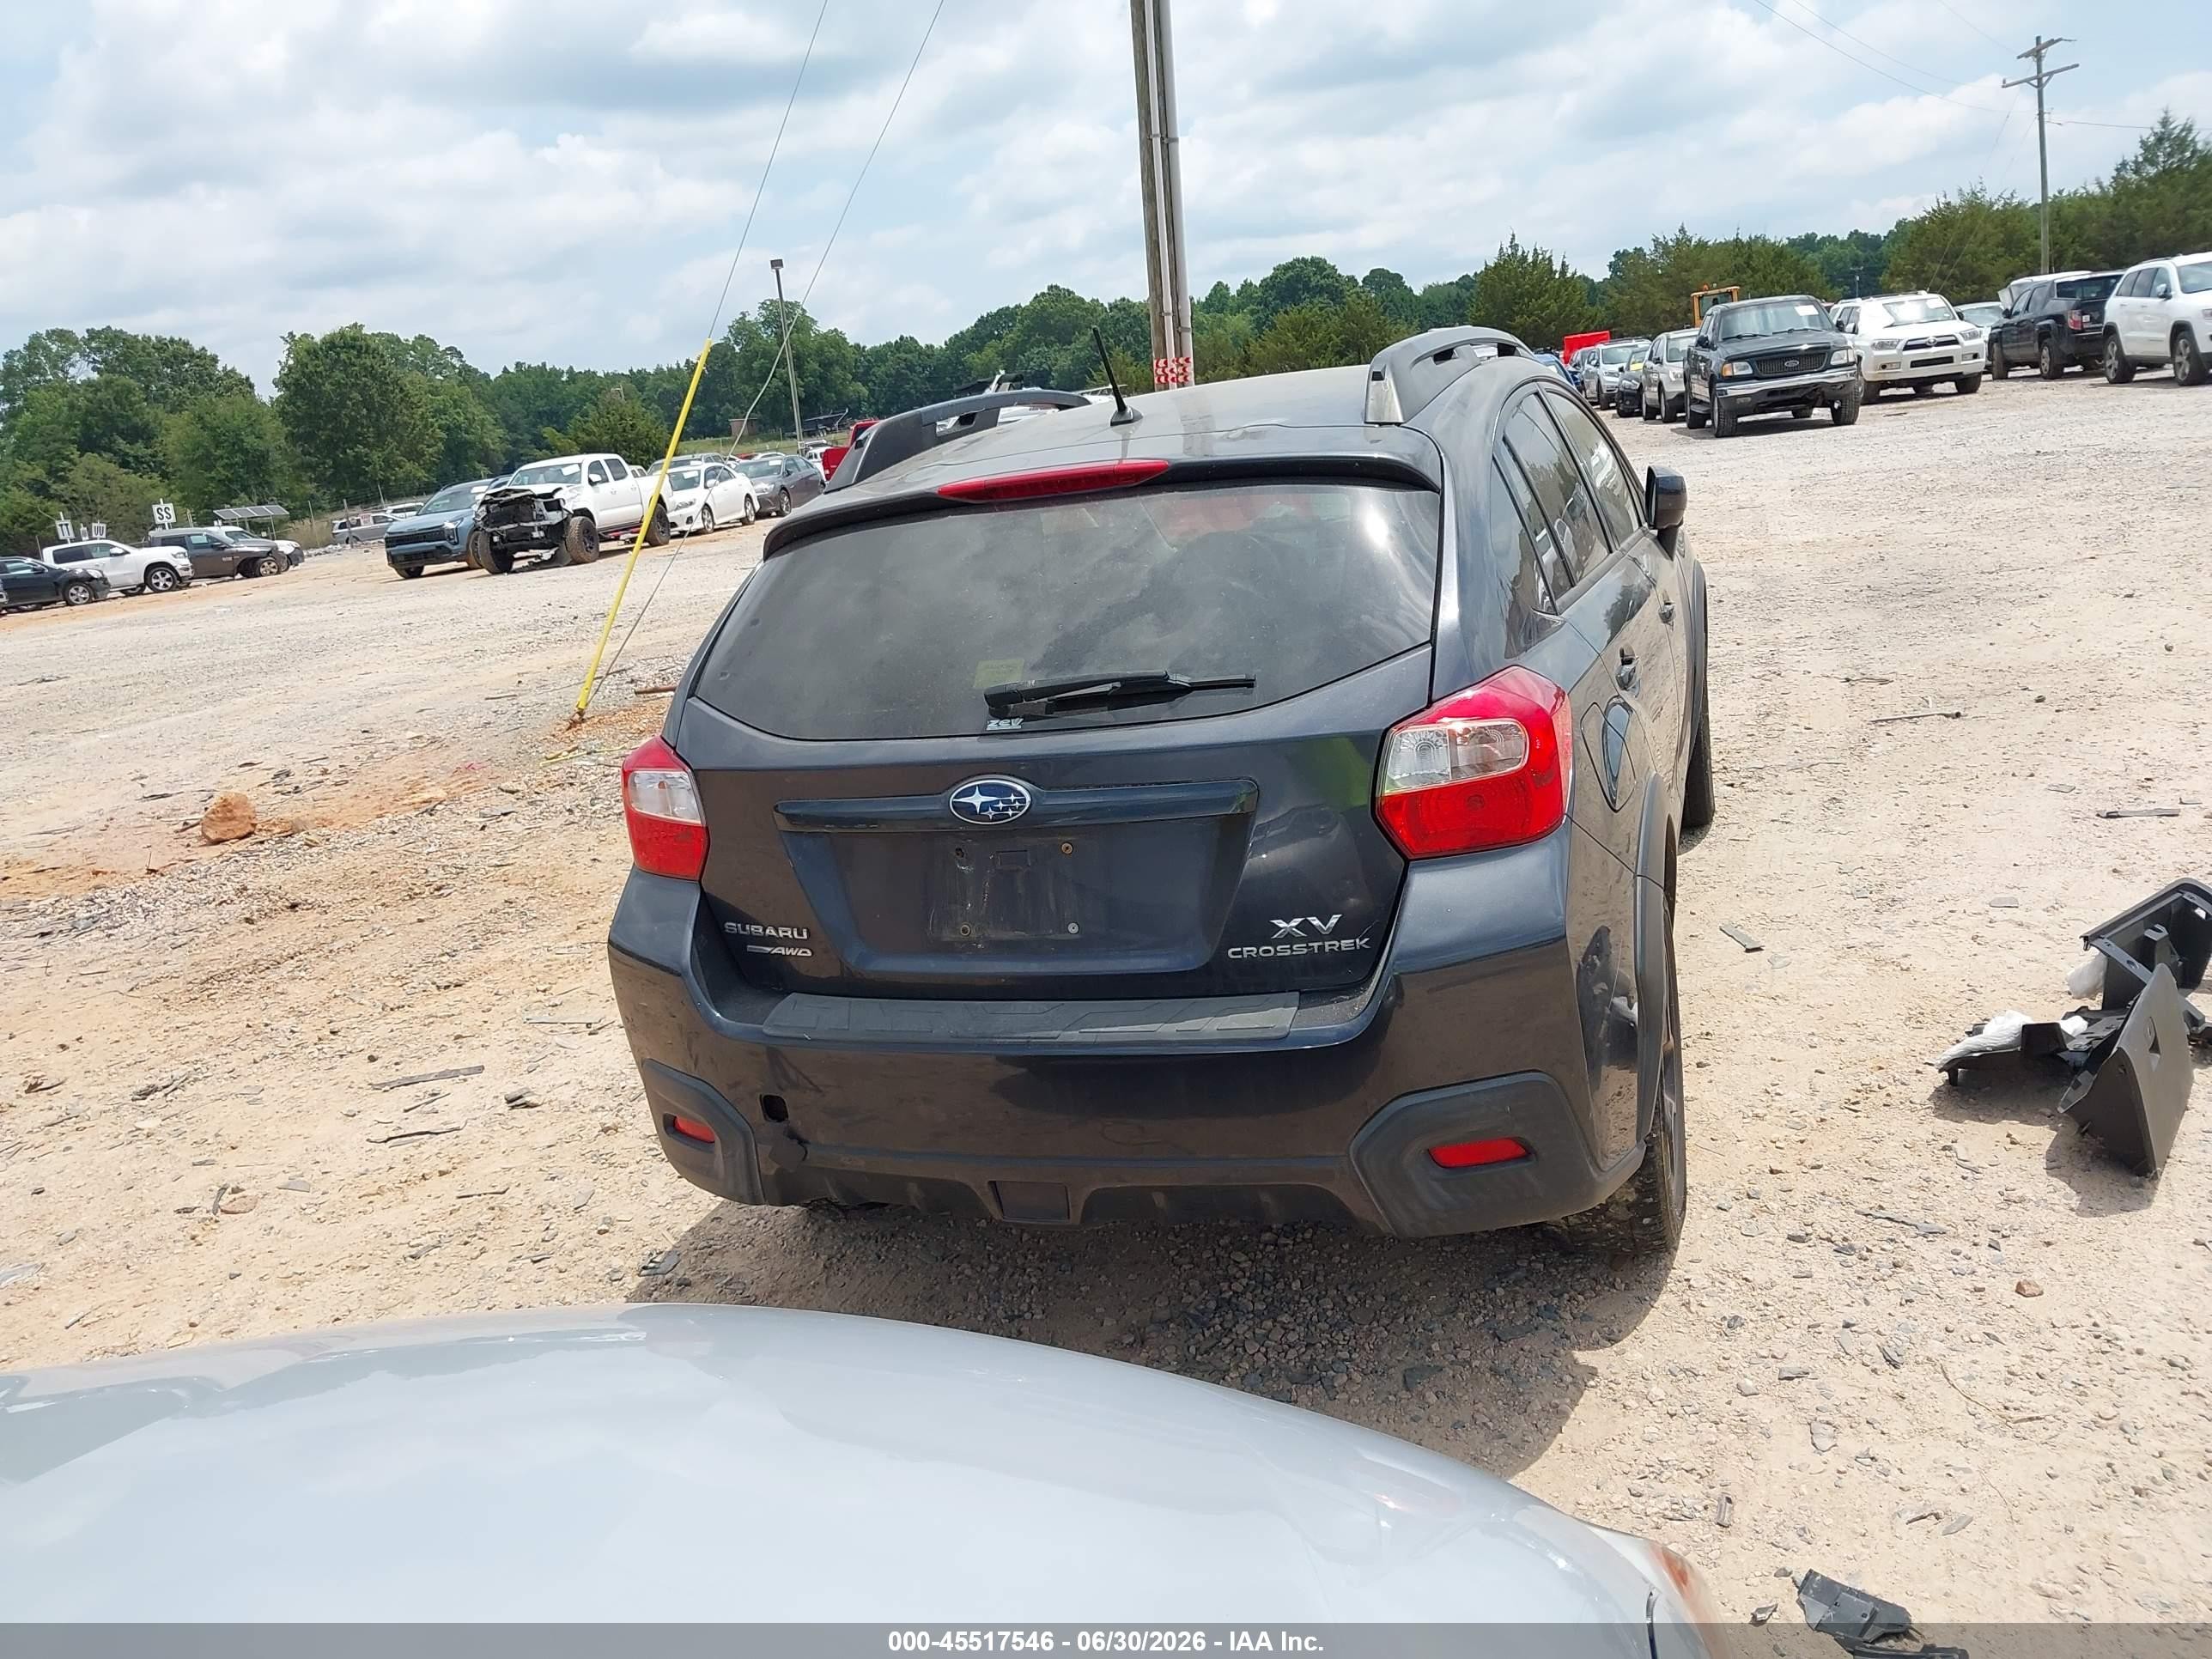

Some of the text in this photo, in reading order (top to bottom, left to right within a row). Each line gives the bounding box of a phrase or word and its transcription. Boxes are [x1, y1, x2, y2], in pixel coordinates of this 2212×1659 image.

[156, 507, 172, 520] SS
[724, 921, 808, 939] SUBARU
[1269, 914, 1342, 939] XV
[770, 946, 813, 957] AWD
[1227, 938, 1371, 959] CROSSTREK
